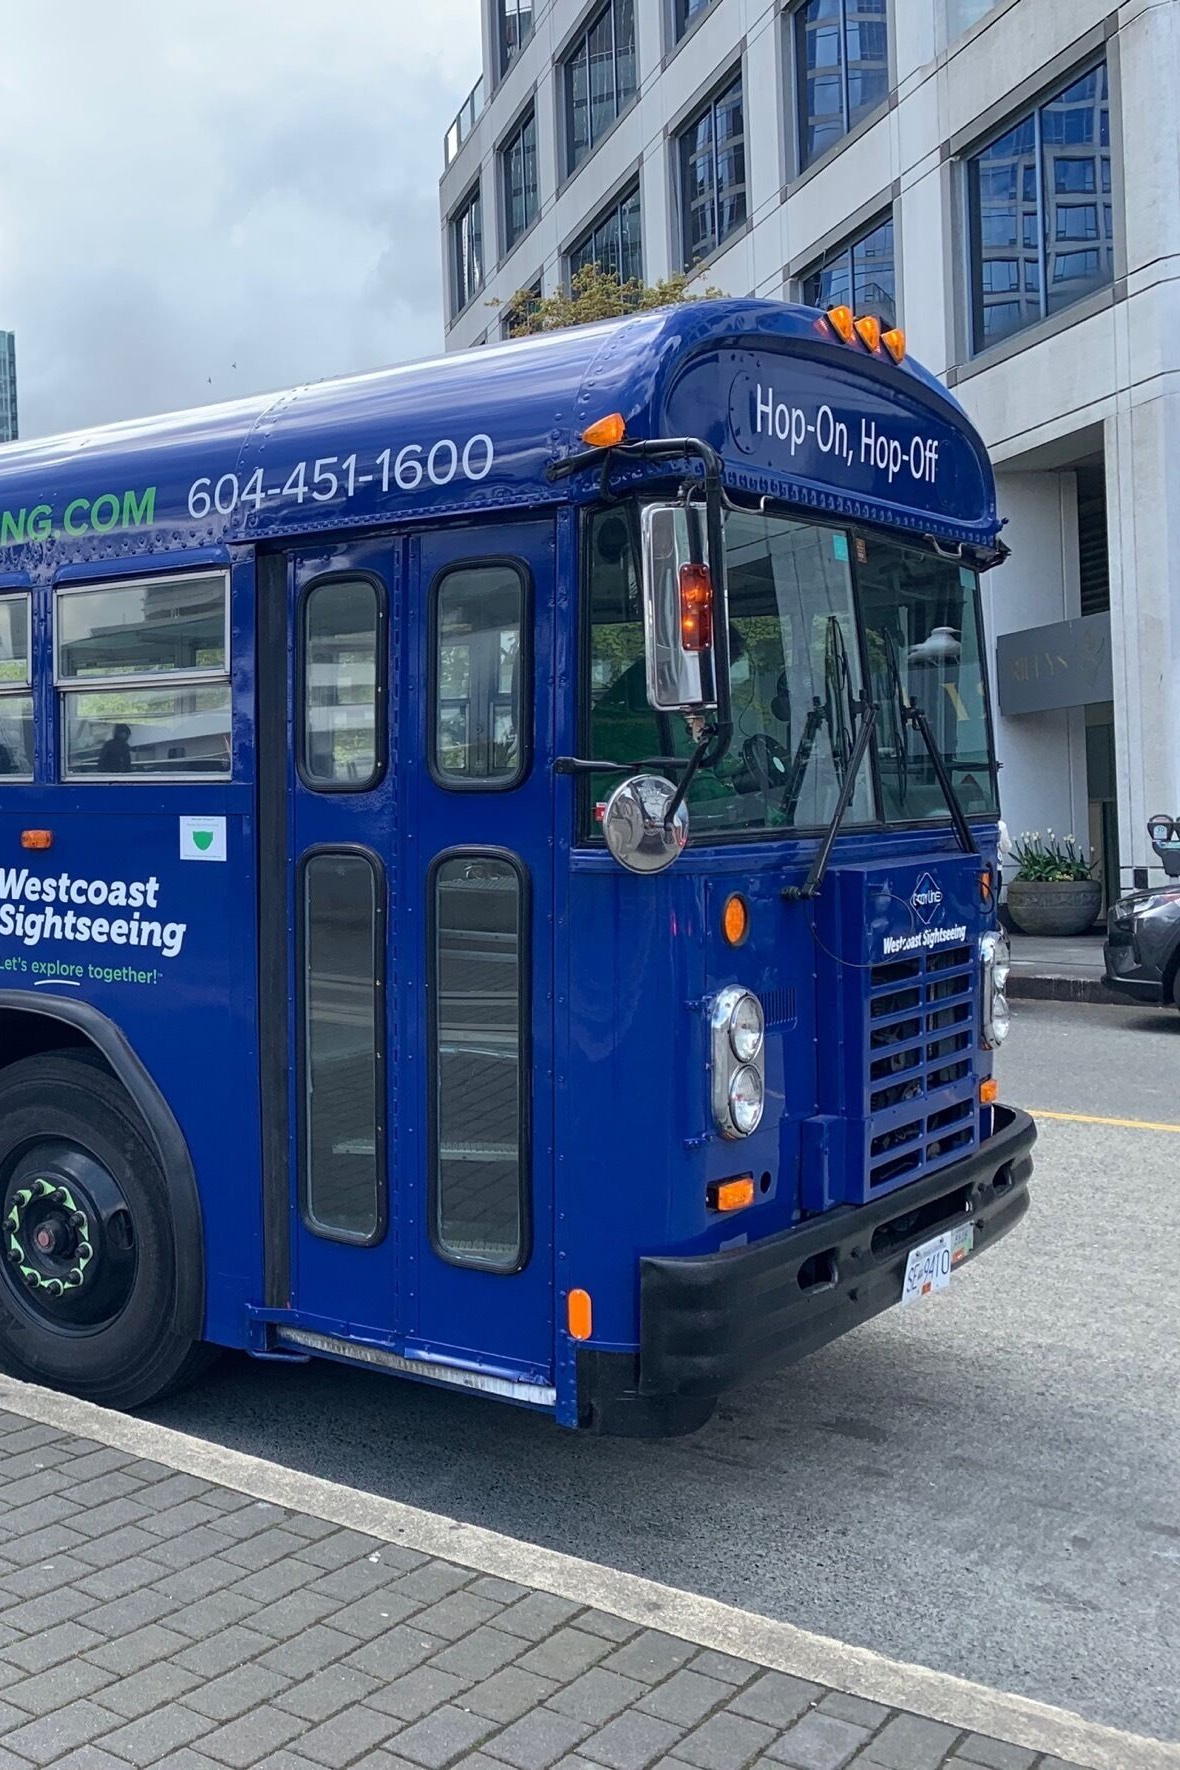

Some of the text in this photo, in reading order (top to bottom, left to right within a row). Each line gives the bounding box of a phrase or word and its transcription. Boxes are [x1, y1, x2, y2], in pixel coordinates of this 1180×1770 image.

[756, 384, 939, 483] Hop-On, Hop-Off
[187, 433, 495, 519] 604-451-1600
[922, 924, 967, 948] Sightseeing
[31, 960, 84, 977] explore
[88, 963, 158, 985] together!
